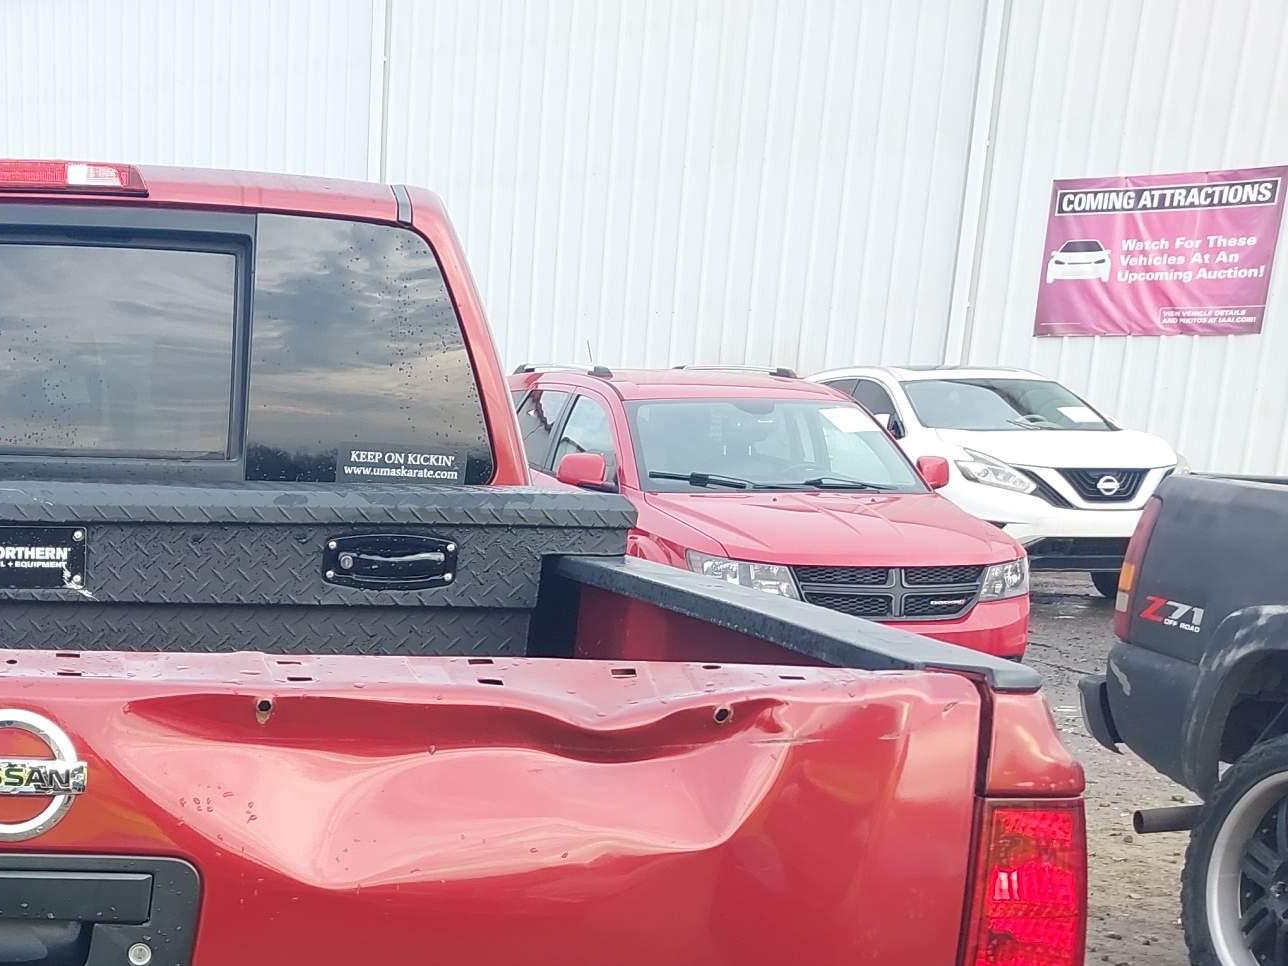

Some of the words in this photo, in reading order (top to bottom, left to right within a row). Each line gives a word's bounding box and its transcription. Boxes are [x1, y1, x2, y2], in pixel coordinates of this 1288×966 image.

[1062, 191, 1135, 212] COMING
[1138, 182, 1273, 209] ATTRACTIONS
[1121, 238, 1169, 250] Watch
[1175, 236, 1202, 249] For
[1207, 235, 1257, 248] These
[1119, 254, 1185, 266] Vehicles
[1191, 252, 1210, 264] At
[1214, 252, 1239, 263] An
[1117, 269, 1192, 283] Upcoming
[1195, 265, 1264, 280] Auction!
[350, 450, 383, 463] KEEP
[384, 452, 405, 464] ON
[407, 453, 455, 466] KICKIN'
[343, 465, 458, 480] www.umaskarate.com
[14, 561, 67, 569] EQUIPMENT
[1139, 595, 1204, 626] Z71
[1163, 618, 1177, 627] OFF
[1179, 622, 1200, 633] ROAD
